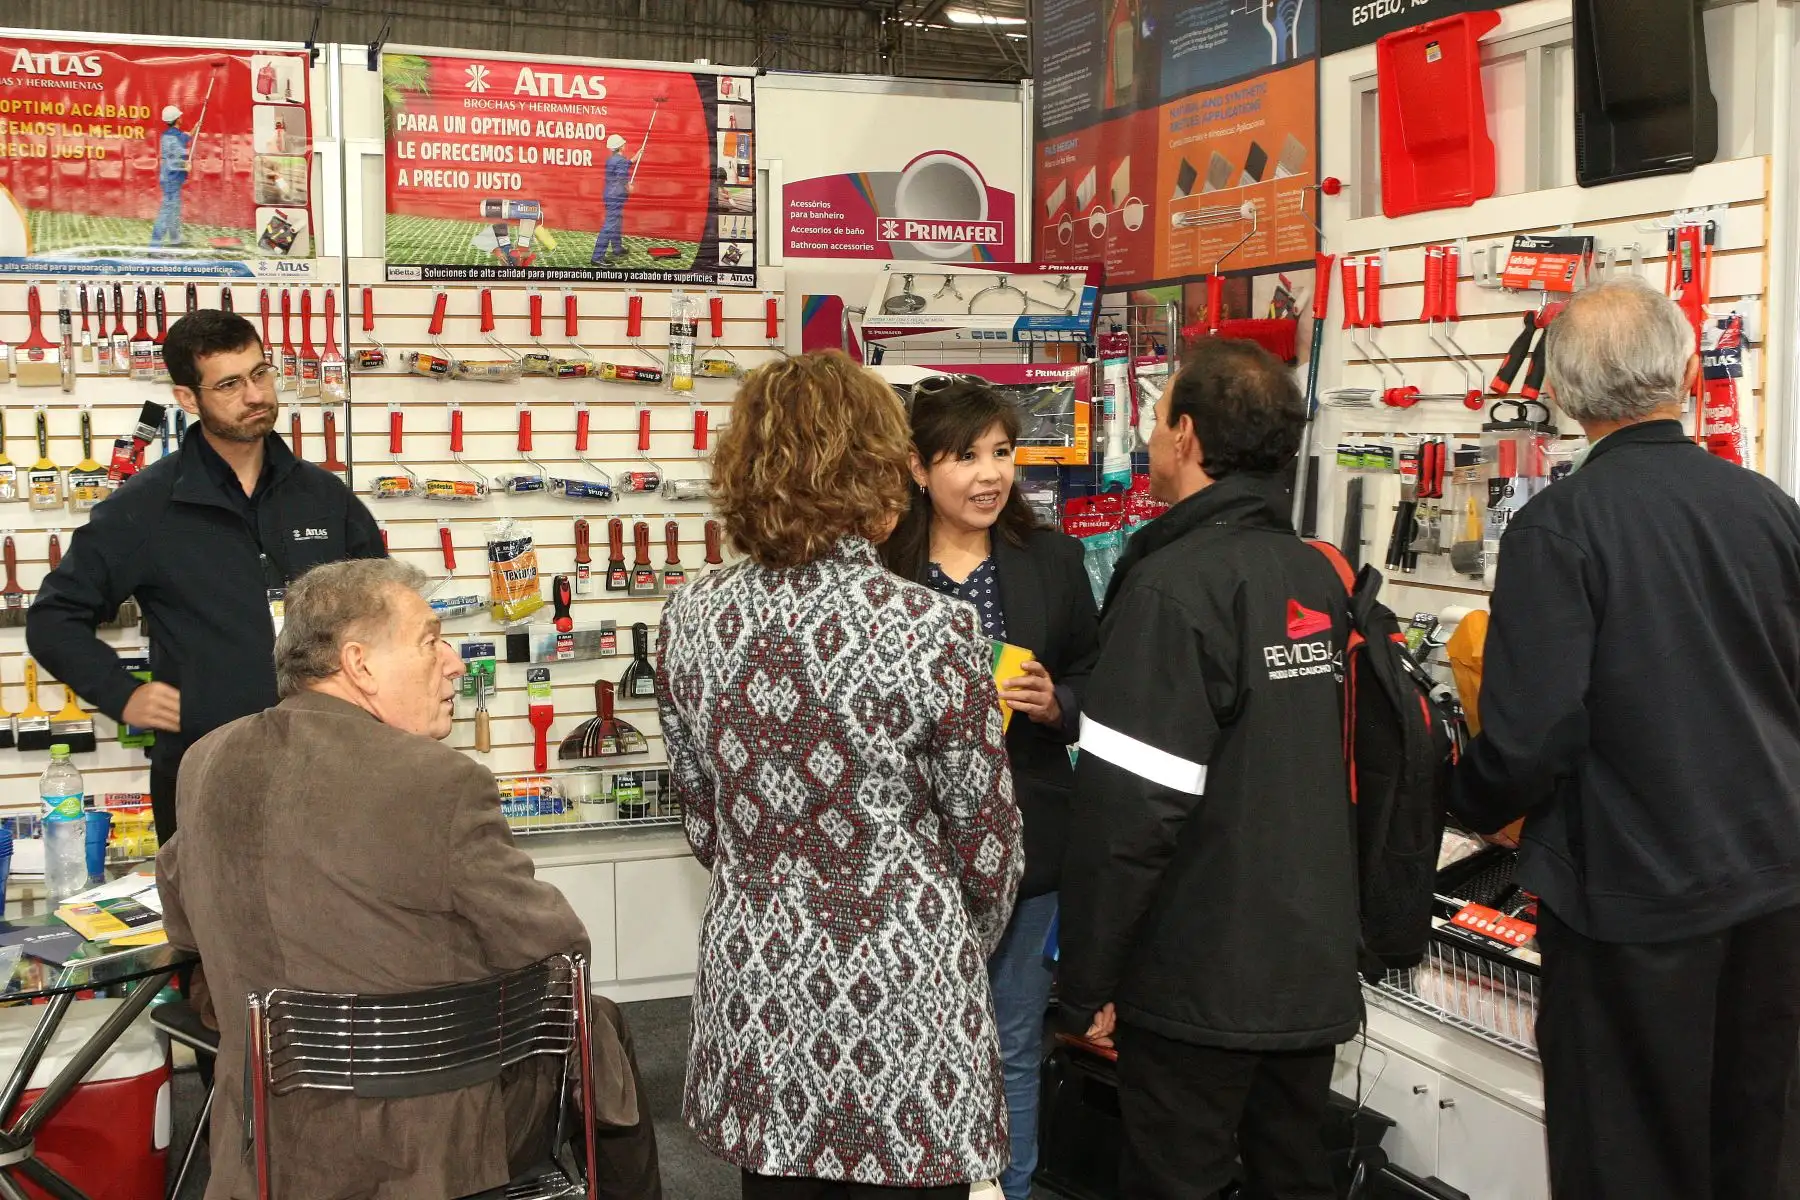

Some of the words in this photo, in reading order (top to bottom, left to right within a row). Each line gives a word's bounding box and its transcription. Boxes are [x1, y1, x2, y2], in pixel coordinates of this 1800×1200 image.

[11, 48, 103, 77] ATLAS
[26, 79, 104, 91] HERRAMIENTAS
[514, 67, 607, 100] ATLAS
[0, 99, 65, 116] OPTIMO
[71, 103, 151, 119] ACABADO
[464, 98, 515, 111] BROCHAS
[519, 101, 526, 111] Y
[529, 102, 608, 116] HERRAMIENTAS
[61, 123, 83, 137] LO
[88, 124, 145, 140] MEJOR
[397, 113, 439, 133] PARA
[443, 116, 466, 134] UN
[471, 117, 531, 137] OPTIMO
[535, 120, 606, 141] ACABADO
[52, 144, 105, 159] JUSTO
[397, 141, 416, 160] LE
[420, 142, 514, 164] OFRECEMOS
[518, 146, 538, 165] LO
[542, 148, 593, 167] MEJOR
[398, 168, 409, 187] A
[413, 169, 469, 189] PRECIO
[474, 171, 522, 190] JUSTO
[790, 200, 831, 208] Acessórios
[809, 211, 845, 219] banheiro
[790, 225, 831, 234] Accesorios
[833, 226, 844, 234] de
[845, 227, 865, 235] baño
[905, 221, 997, 242] PRIMAFER
[790, 241, 829, 249] Bathroom
[830, 242, 874, 250] accessories
[152, 265, 182, 273] acabado
[276, 261, 310, 272] ATLAS
[389, 268, 414, 276] InBetta
[424, 267, 467, 278] Soluciones
[468, 268, 479, 278] de
[480, 268, 496, 278] alta
[498, 268, 526, 278] calidad
[527, 270, 545, 280] para
[546, 269, 595, 281] preparación,
[596, 270, 622, 281] pintura
[624, 273, 629, 281] y
[630, 272, 661, 281] acabado
[663, 273, 672, 281] de
[674, 273, 715, 284] superficies.
[729, 273, 753, 282] ATLAS
[1035, 369, 1076, 377] PRIMAFER
[305, 528, 328, 536] ATLAS
